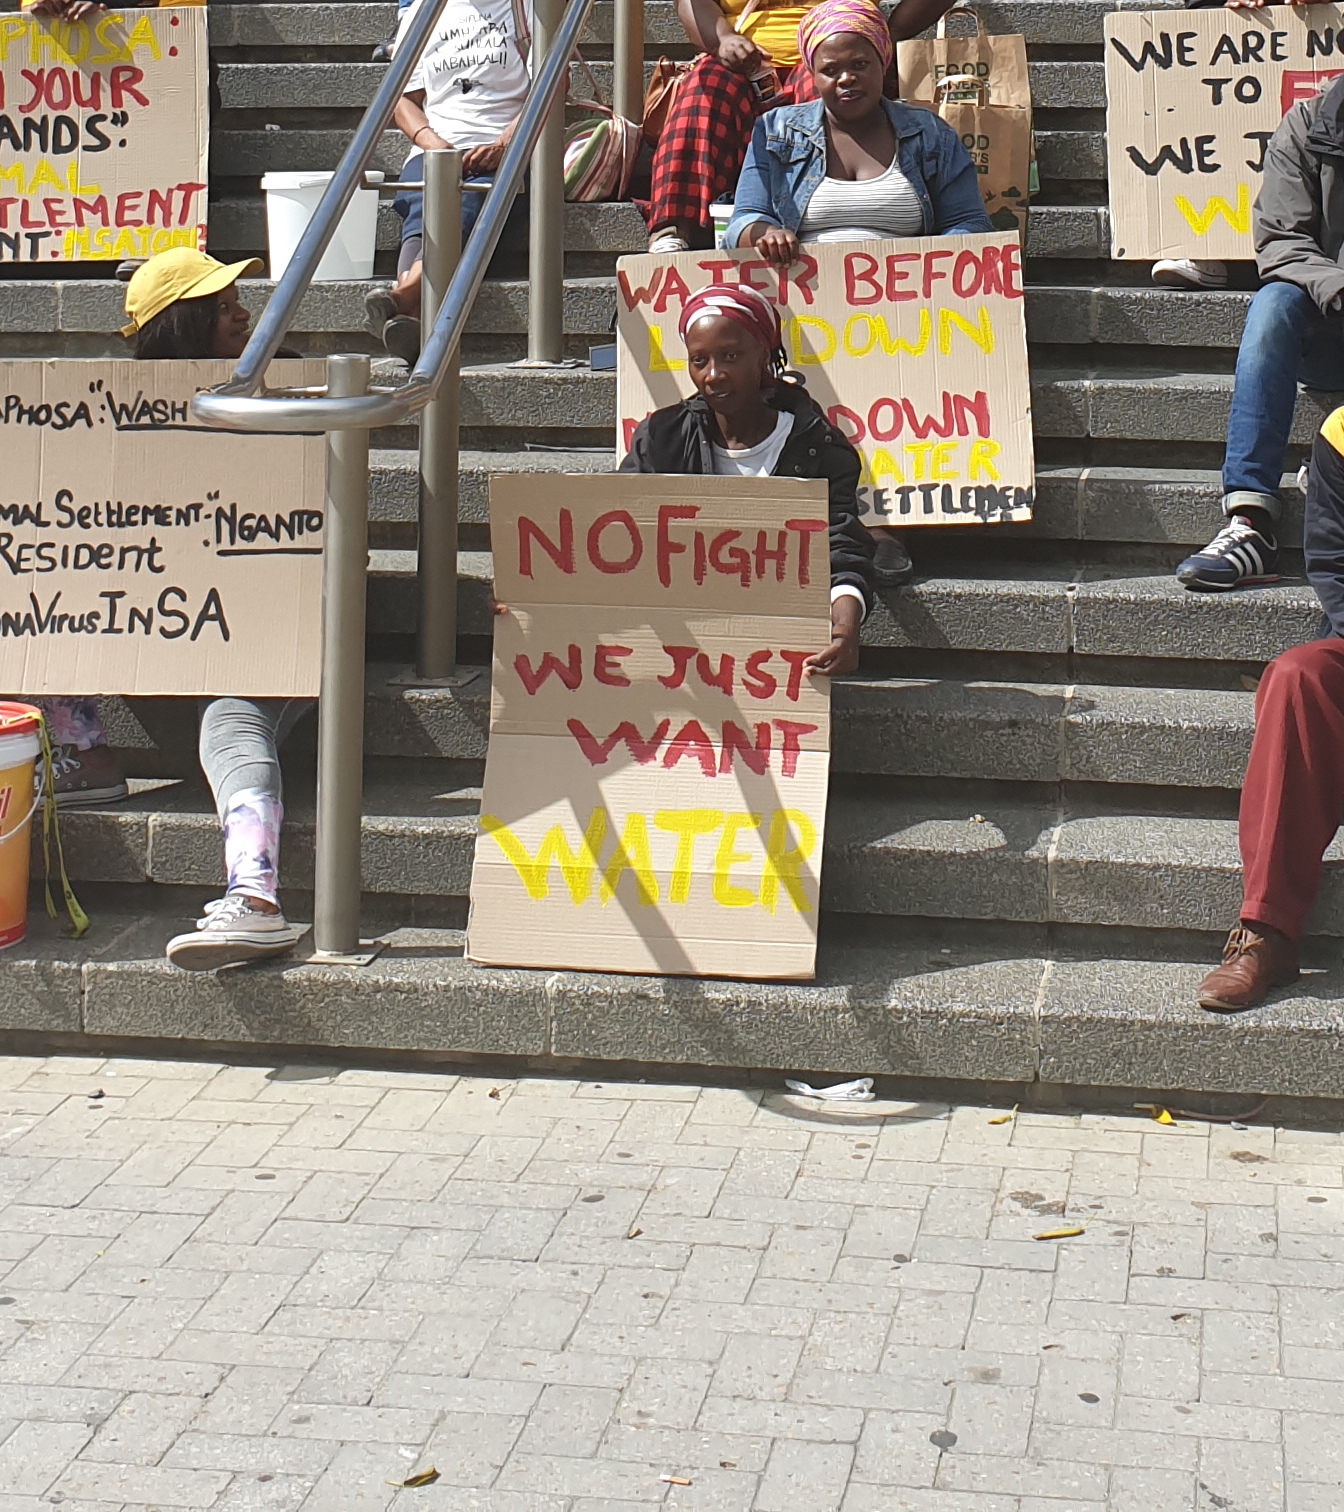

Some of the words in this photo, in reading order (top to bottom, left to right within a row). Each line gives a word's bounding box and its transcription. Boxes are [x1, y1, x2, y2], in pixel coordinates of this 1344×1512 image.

[1111, 29, 1197, 72] WE
[1210, 29, 1289, 66] ARE
[19, 65, 150, 113] YOUR
[1202, 75, 1262, 106] TO
[1126, 133, 1222, 175] WE
[617, 254, 818, 313] WATER
[843, 244, 1026, 306] BEFORE
[516, 507, 644, 580] NO
[656, 504, 828, 588] FIGHT
[512, 643, 634, 697] WE
[657, 645, 812, 705] JUST
[566, 717, 819, 779] WANT
[480, 803, 818, 915] WATER
